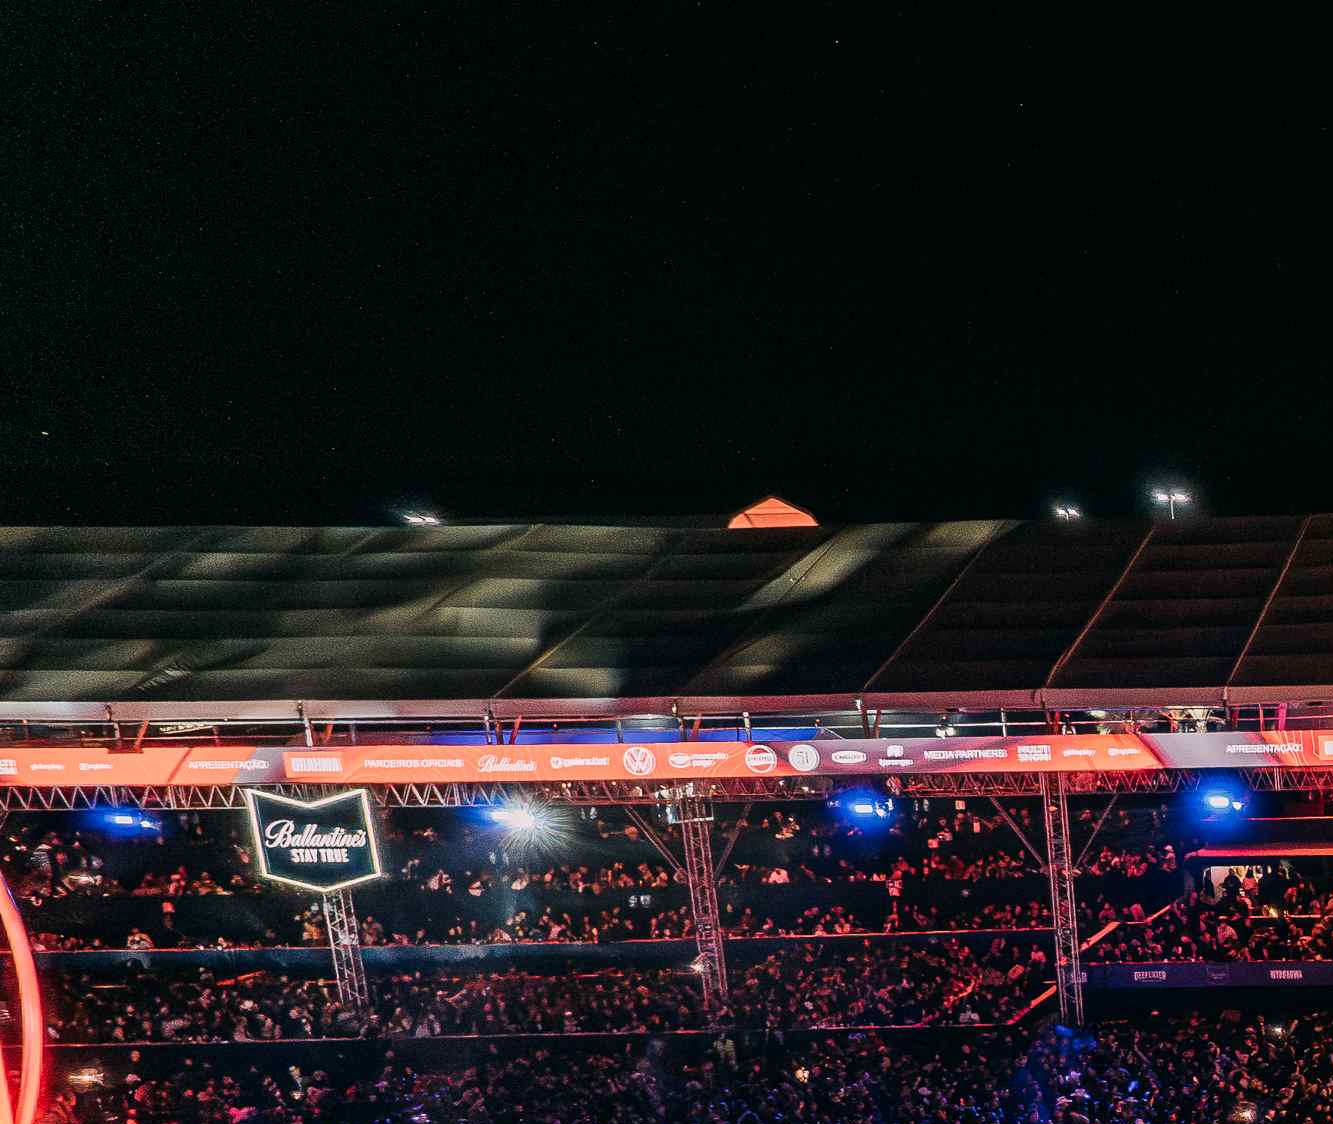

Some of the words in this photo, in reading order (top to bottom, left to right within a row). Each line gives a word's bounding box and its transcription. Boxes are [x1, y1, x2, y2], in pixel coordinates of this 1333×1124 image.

[265, 820, 366, 848] Ballantine's
[290, 848, 317, 863] STAY
[319, 848, 349, 863] TRUE
